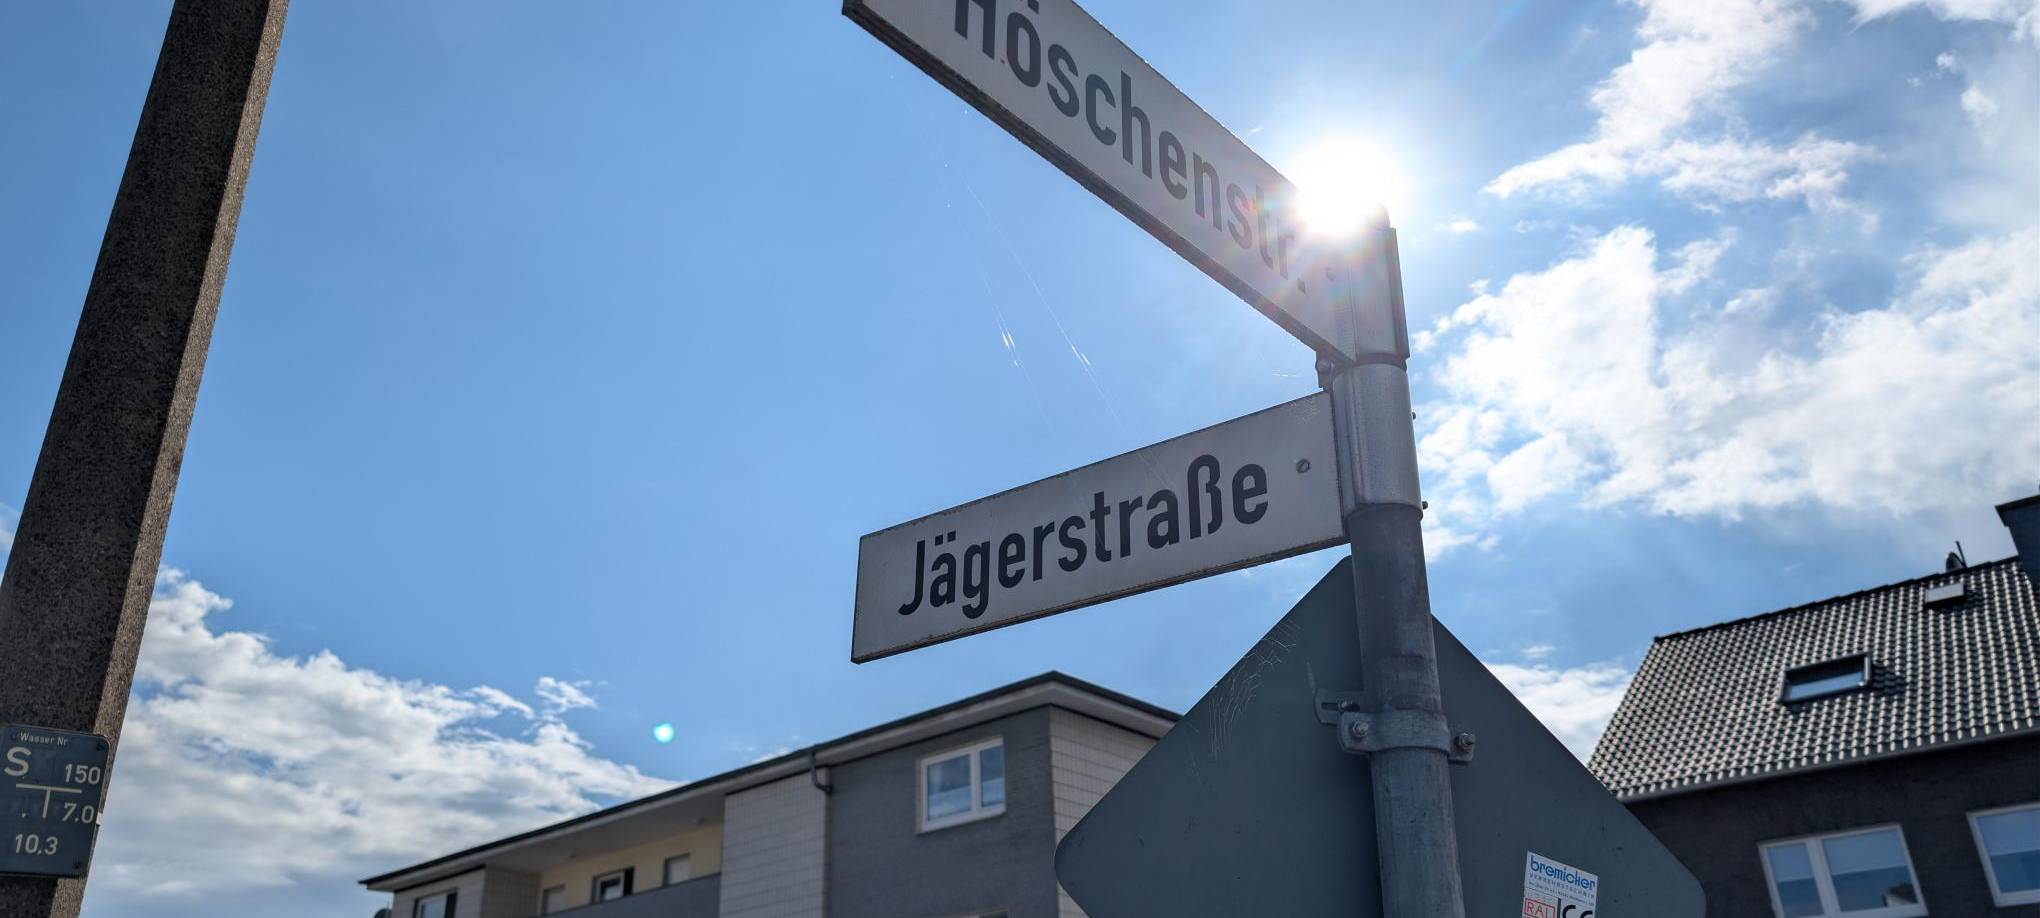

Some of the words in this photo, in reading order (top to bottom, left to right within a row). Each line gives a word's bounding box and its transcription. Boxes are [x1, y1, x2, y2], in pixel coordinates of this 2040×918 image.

[898, 453, 1269, 619] Jägerstraße
[20, 731, 54, 744] Wasser
[4, 746, 32, 777] S
[65, 763, 100, 785] 150
[62, 802, 95, 824] 7,0
[15, 834, 58, 856] 10,3
[1530, 855, 1596, 890] bremicker
